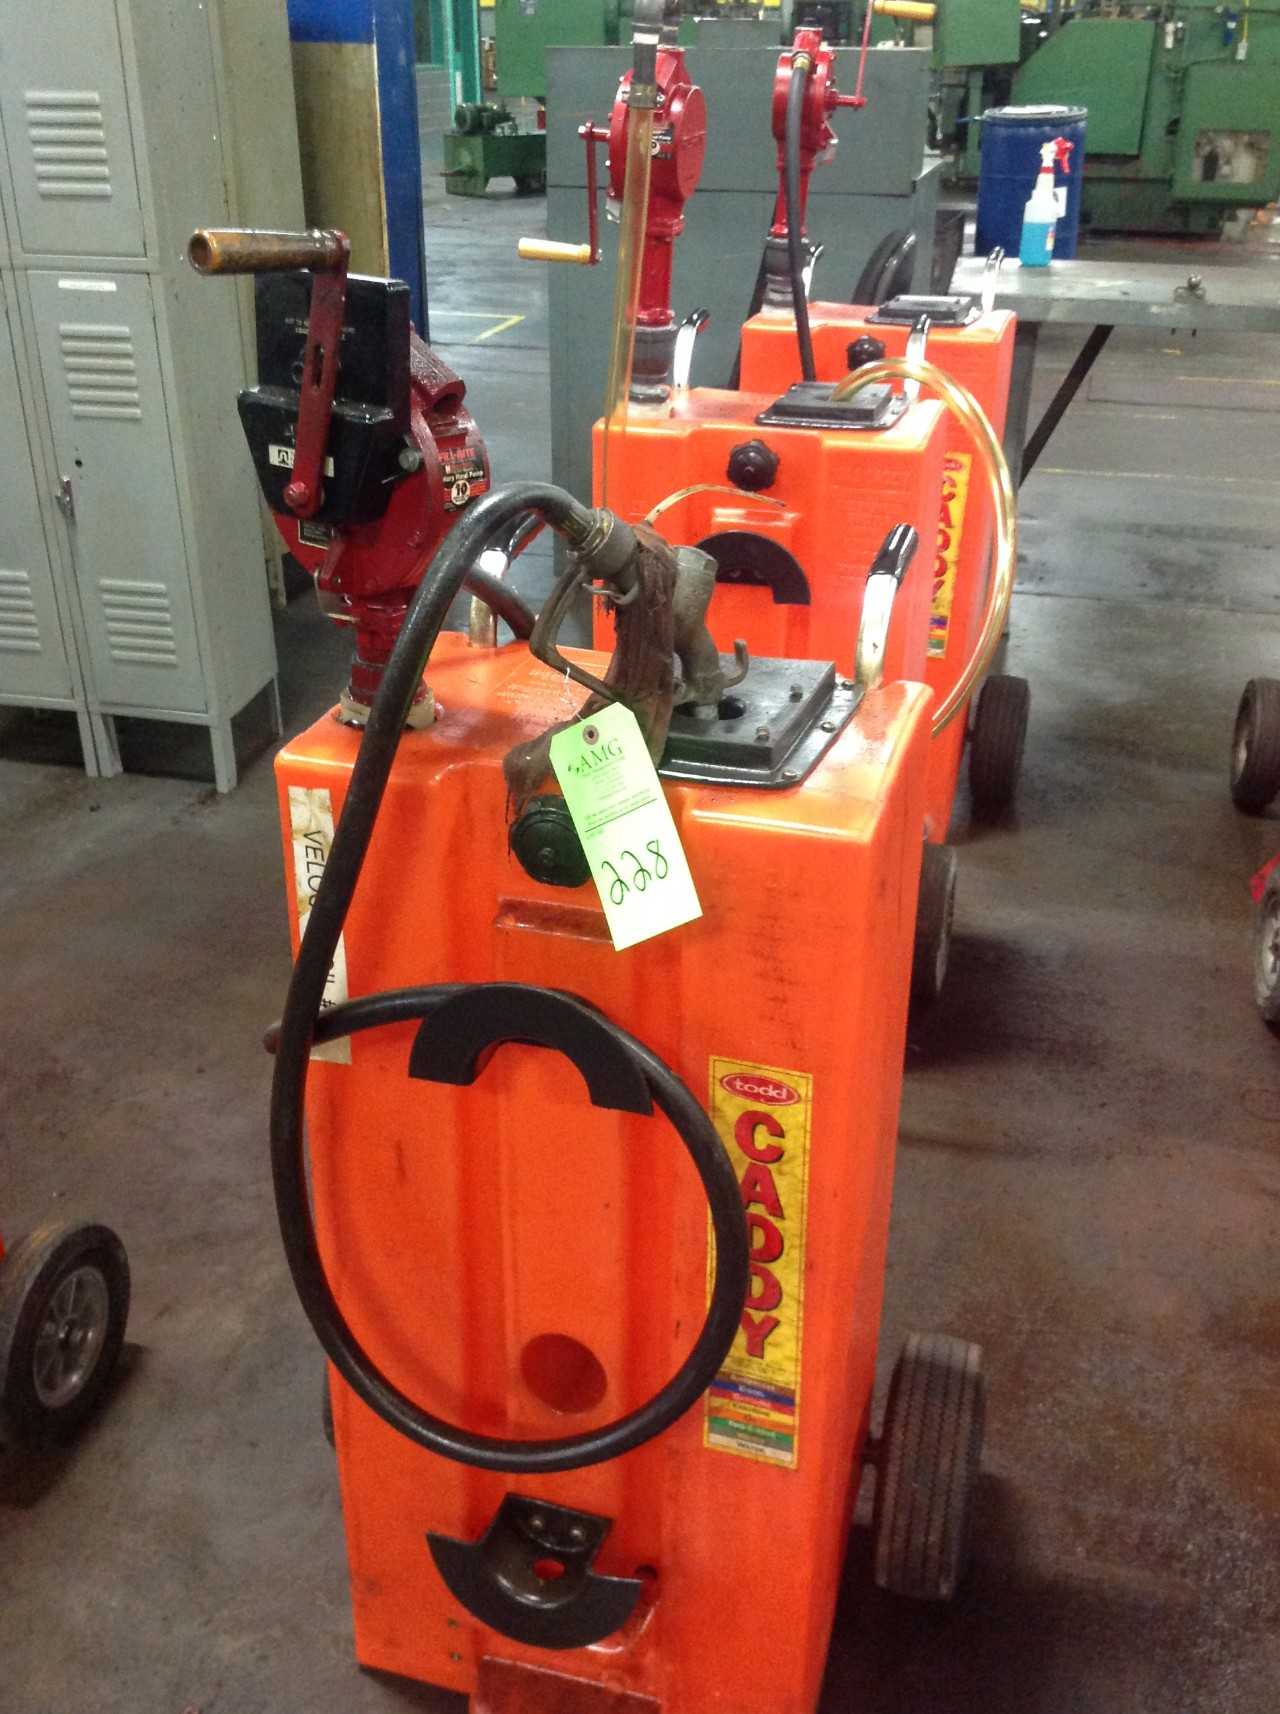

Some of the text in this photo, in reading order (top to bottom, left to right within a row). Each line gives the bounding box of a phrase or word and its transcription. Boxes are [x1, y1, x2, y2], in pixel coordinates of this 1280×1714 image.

[456, 482, 468, 496] 10
[601, 839, 669, 905] 228
[734, 1078, 788, 1100] todd
[734, 1109, 786, 1360] CADDY
